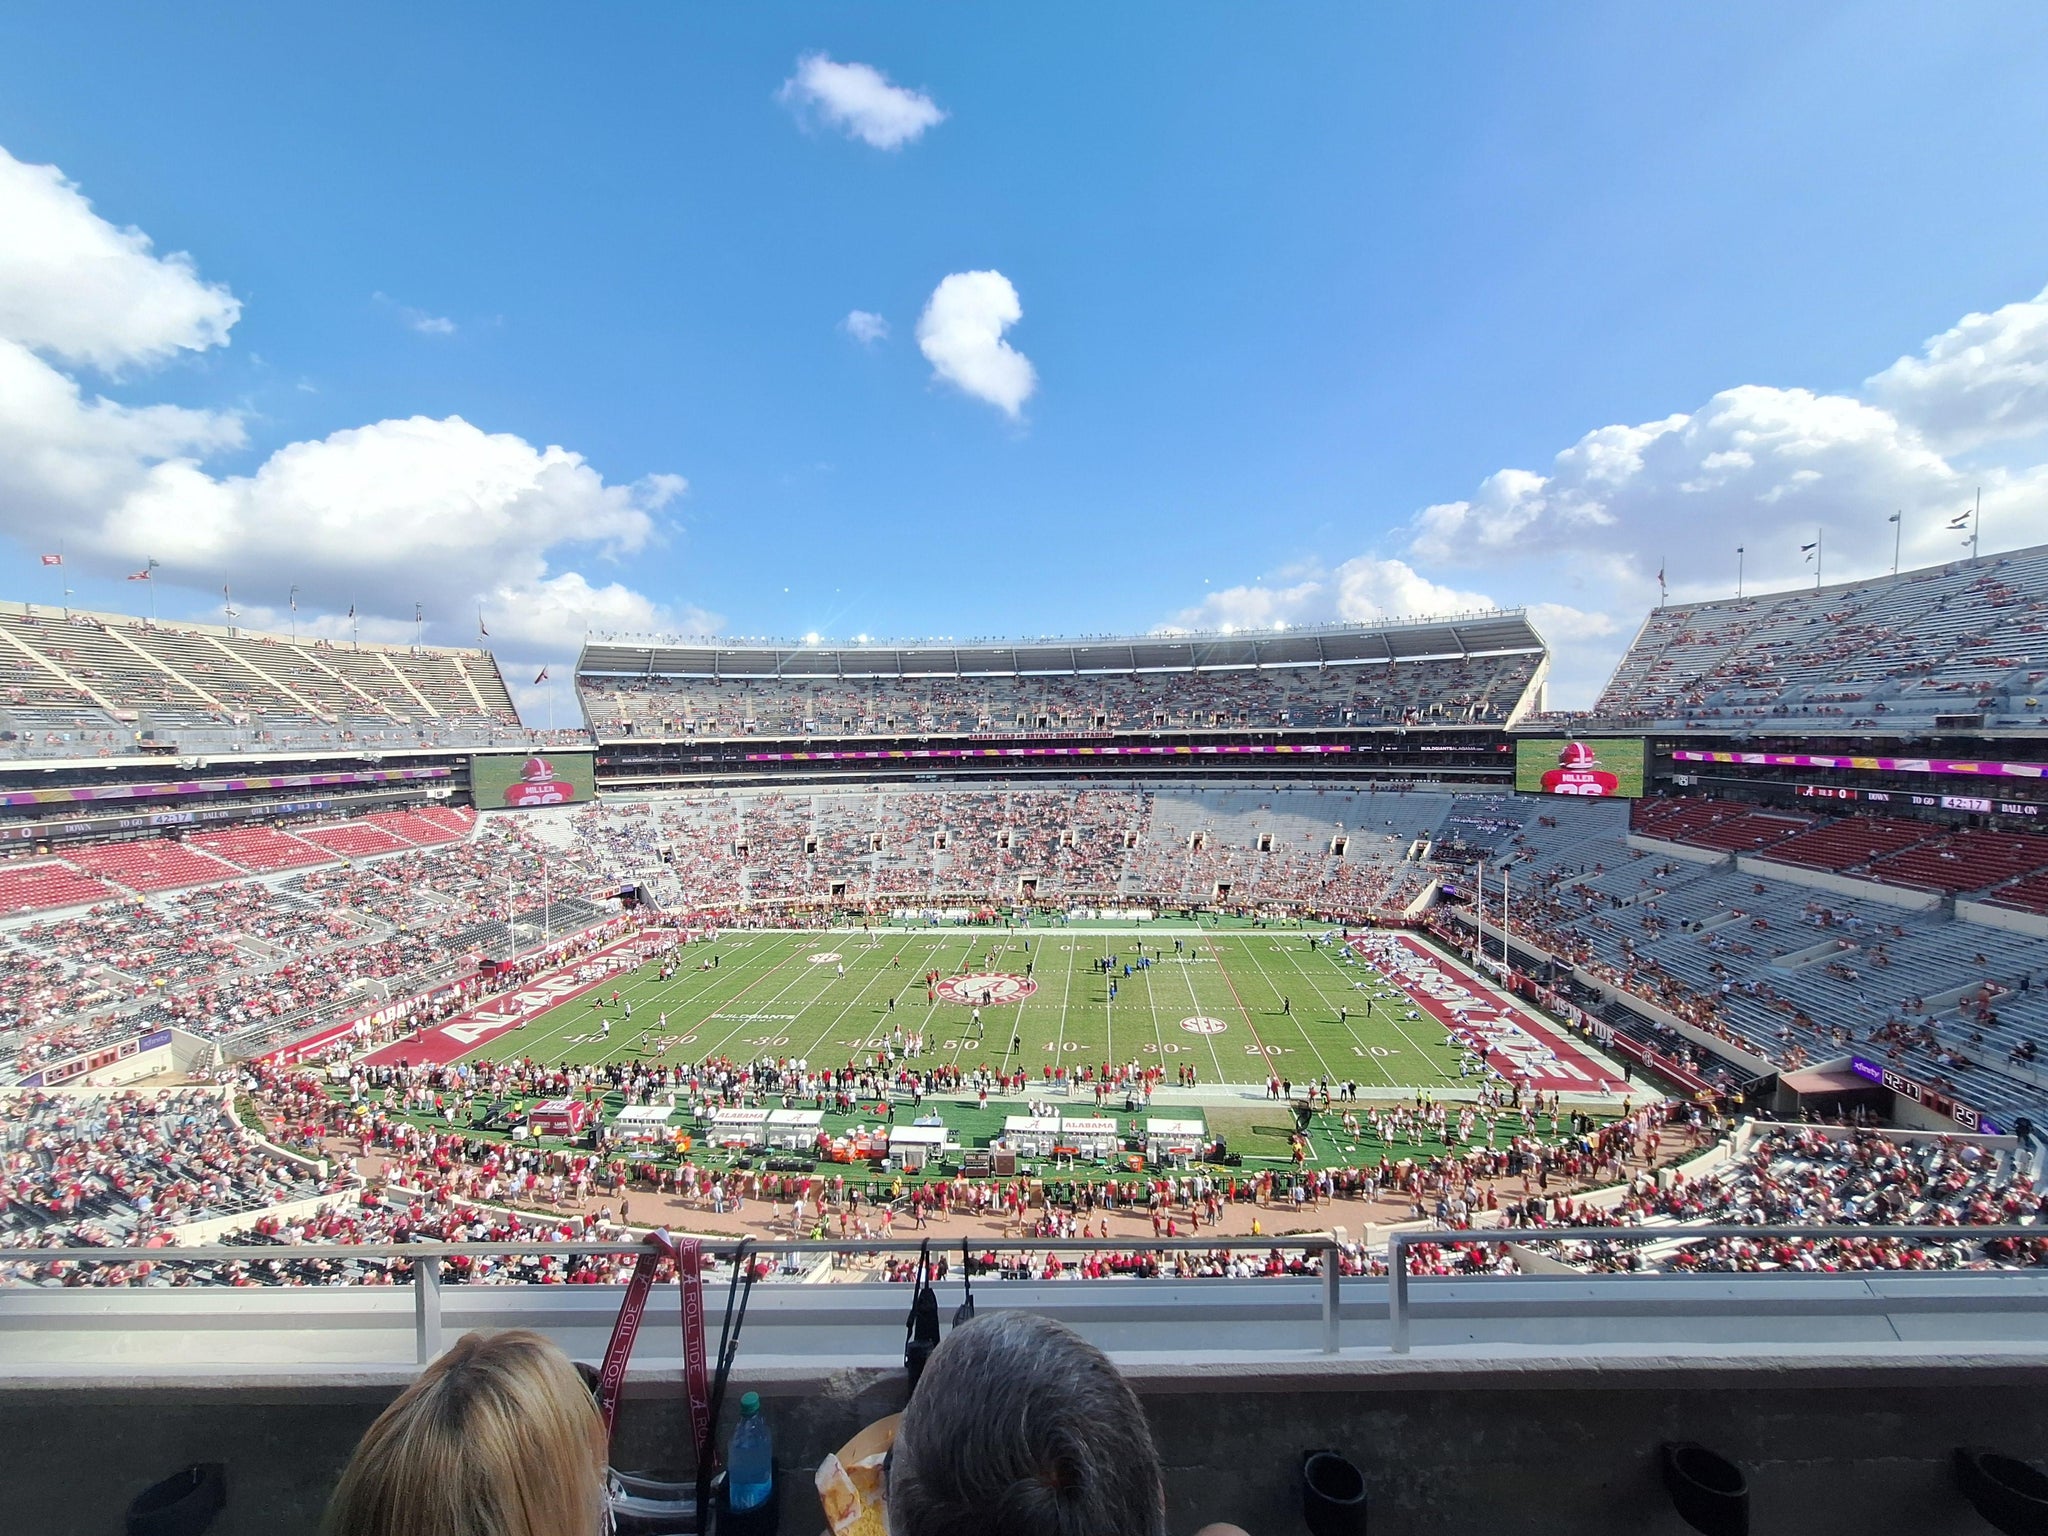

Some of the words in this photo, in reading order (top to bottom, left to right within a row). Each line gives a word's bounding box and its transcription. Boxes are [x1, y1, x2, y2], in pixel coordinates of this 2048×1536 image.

[1562, 774, 1594, 782] MILLER
[525, 786, 554, 794] MILLER
[1838, 789, 1846, 798] 0
[1868, 792, 1889, 802] DOWN
[1912, 796, 1922, 805] TO
[1923, 797, 1934, 806] GO
[1948, 798, 1982, 810] 42:17
[2001, 803, 2023, 815] BALL
[2024, 805, 2038, 816] ON
[156, 813, 188, 824] 42:17
[202, 811, 218, 820] BALL
[219, 810, 229, 818] ON
[65, 822, 92, 833] DOWN
[119, 819, 130, 828] TO
[131, 818, 143, 827] GO
[21, 828, 31, 838] 0
[1183, 1017, 1225, 1033] SEC
[1586, 1013, 1614, 1047] TIDE
[143, 1034, 170, 1048] xfinity
[752, 1036, 789, 1046] 30
[847, 1038, 883, 1048] 40
[943, 1040, 980, 1050] 50
[1041, 1041, 1077, 1052] 40
[1143, 1043, 1180, 1054] 30
[1244, 1044, 1282, 1055] 20
[1351, 1046, 1388, 1057] 10
[1854, 1060, 1880, 1078] xfinity
[1885, 1073, 1918, 1098] 42:17
[1956, 1106, 1975, 1125] 25
[1065, 1121, 1114, 1129] ALABAMA
[684, 1237, 694, 1255] DE
[685, 1292, 698, 1334] ROLL
[604, 1345, 626, 1389] ROLL
[618, 1304, 639, 1337] TIDE
[688, 1337, 701, 1375] TIDE
